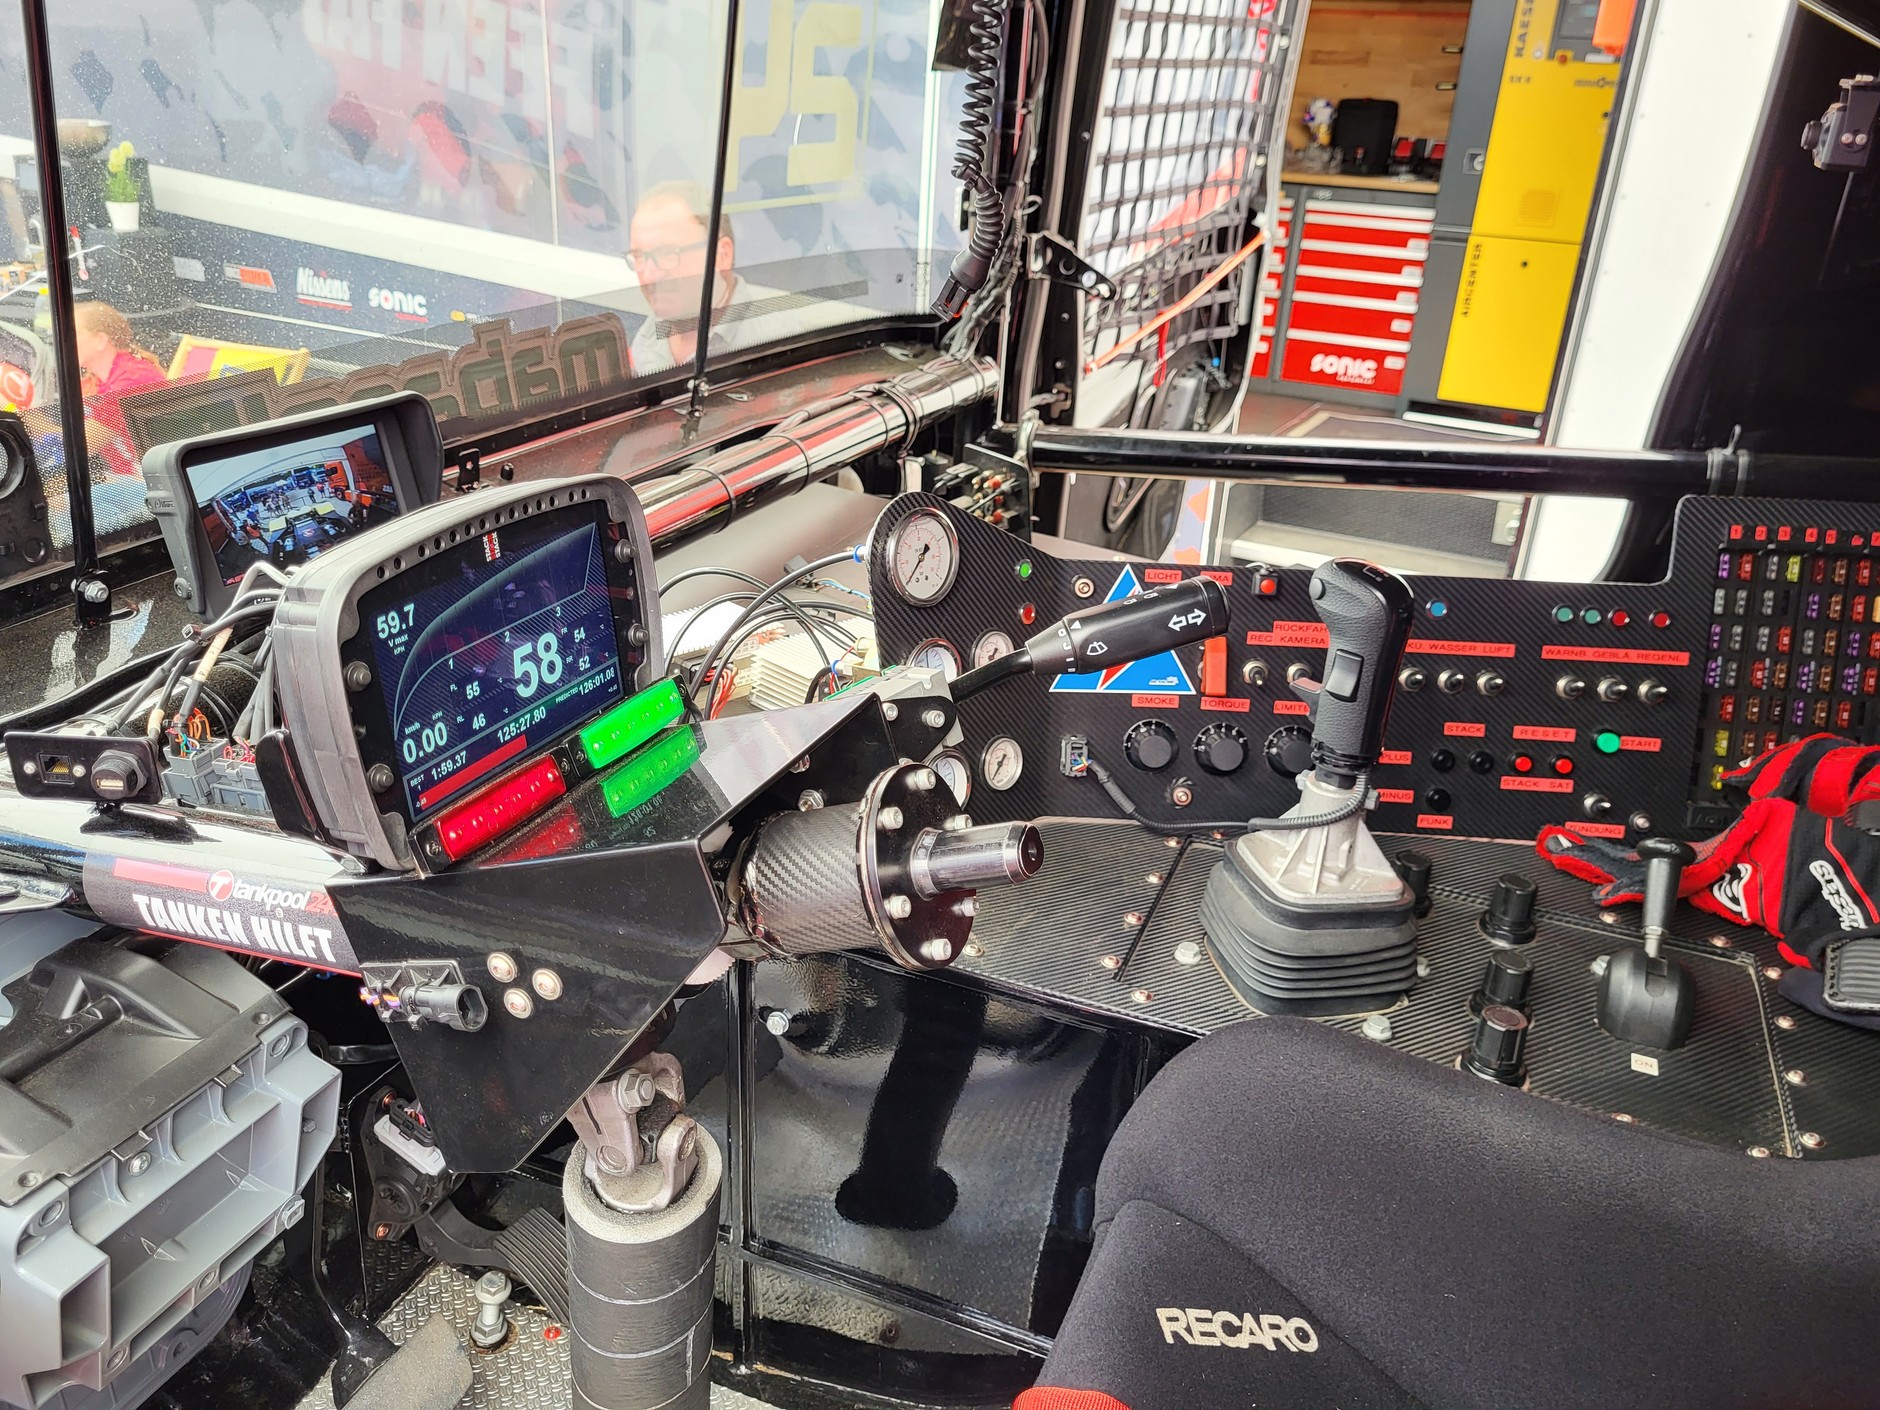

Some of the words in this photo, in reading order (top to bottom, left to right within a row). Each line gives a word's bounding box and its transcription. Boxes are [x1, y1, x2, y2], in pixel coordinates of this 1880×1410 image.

[1147, 572, 1180, 581] LICHT
[555, 606, 561, 617] 3
[377, 603, 415, 639] 59.7
[504, 631, 510, 642] 2
[574, 626, 586, 643] 54
[1250, 634, 1273, 642] REC
[388, 639, 394, 648] V
[394, 634, 409, 646] max
[1279, 635, 1326, 646] KAMERA
[393, 645, 406, 655] KPH
[1428, 642, 1477, 652] WASSER
[1482, 645, 1511, 654] LUFT
[448, 658, 454, 670] 1
[513, 632, 563, 698] 58
[578, 655, 591, 671] 52
[449, 683, 458, 692] FL
[466, 681, 480, 700] 55
[1136, 696, 1176, 706] SMOKE
[1203, 700, 1248, 710] TORQUE
[432, 711, 443, 721] KPH
[456, 714, 465, 724] RL
[472, 713, 486, 731] 46
[497, 706, 546, 744] 125:27.80
[404, 721, 421, 735] km/h
[1446, 725, 1483, 735] STACK
[1519, 728, 1572, 739] RESET
[403, 721, 448, 764] 0.00
[1620, 738, 1660, 748] START
[431, 750, 467, 780] 1:59.37
[410, 774, 425, 787] BEST
[1502, 779, 1540, 788] STACK
[1549, 781, 1572, 790] SAT
[1419, 816, 1450, 826] FUNK
[131, 893, 252, 946] TANKEN
[250, 915, 337, 964] HILFT
[1155, 1306, 1320, 1353] RECARO
